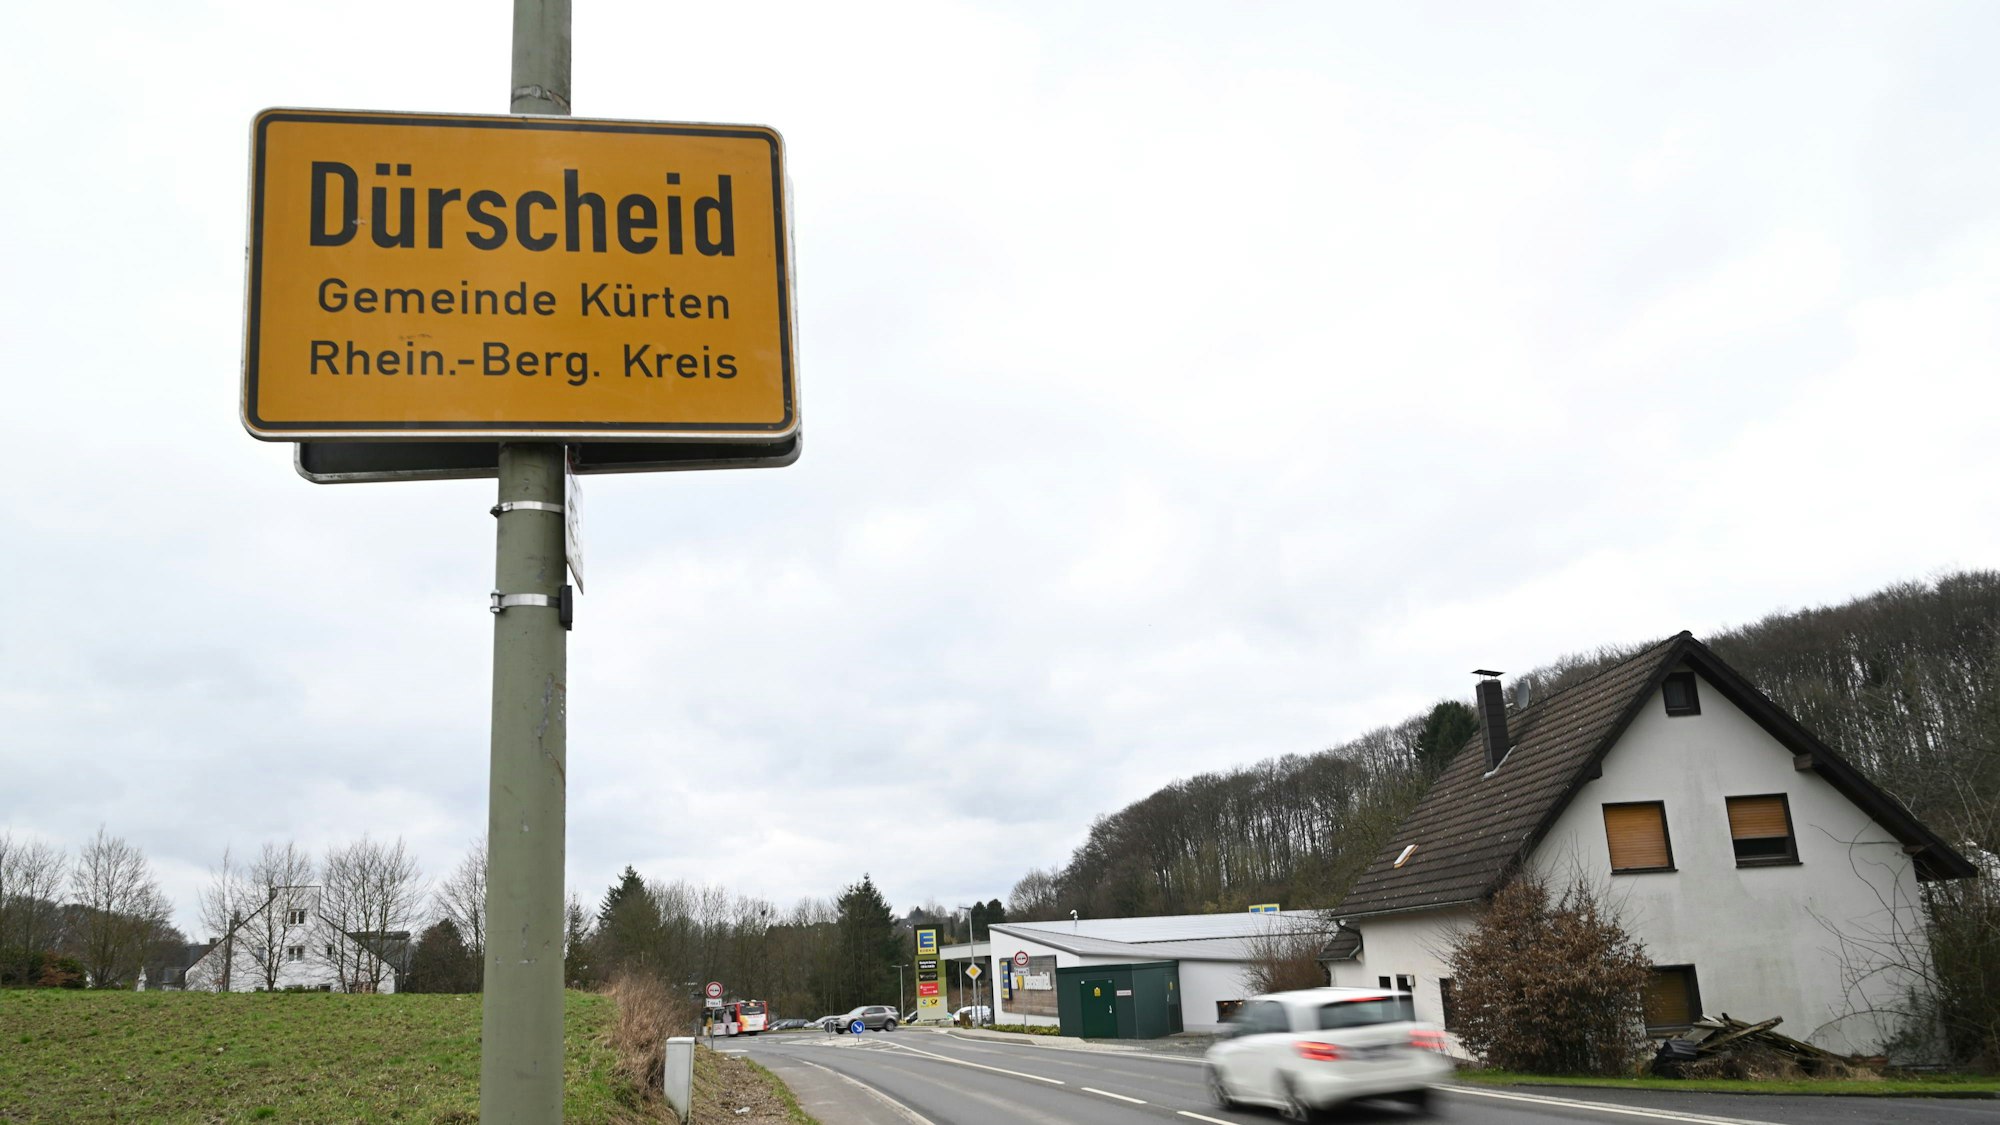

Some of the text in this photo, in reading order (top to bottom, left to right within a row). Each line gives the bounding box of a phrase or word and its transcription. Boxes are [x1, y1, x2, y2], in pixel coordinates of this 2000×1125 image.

[309, 160, 736, 257] Dürscheid
[318, 277, 730, 320] Gemeinde Kürten
[310, 339, 738, 387] Rhein.-Berg. Kreis
[919, 932, 934, 948] E
